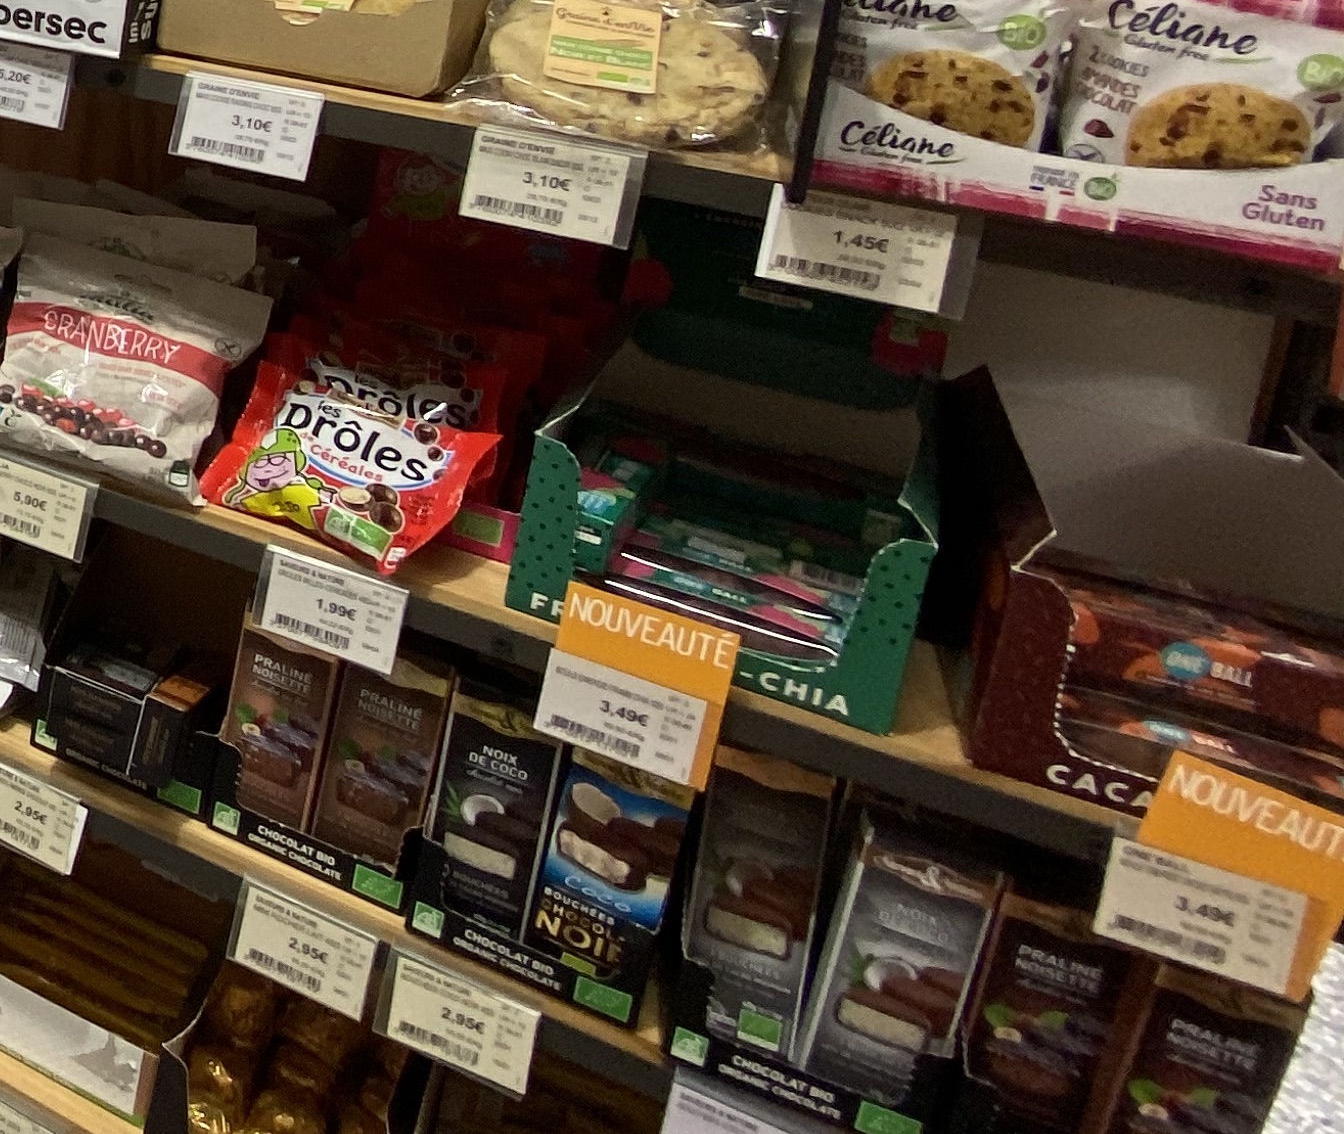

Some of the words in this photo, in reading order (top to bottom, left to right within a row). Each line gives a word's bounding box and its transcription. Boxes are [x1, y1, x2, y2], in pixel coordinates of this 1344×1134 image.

[231, 115, 272, 133] 3,10€
[841, 120, 955, 159] Céliane
[522, 171, 571, 192] 3,10€
[1258, 185, 1318, 210] Sans
[1241, 202, 1325, 232] Gluten
[832, 229, 889, 254] 1,45€
[43, 309, 182, 363] CRANBERRY
[283, 399, 430, 483] Drôles
[13, 491, 48, 512] 5,90€
[315, 597, 358, 622] 1,99€
[568, 592, 738, 670] NOUVEAUTÉ
[598, 698, 650, 728] 3,49€
[468, 751, 487, 767] DE
[489, 759, 529, 781] COCO
[482, 745, 519, 765] NOIX
[247, 832, 287, 858] ORGANIC
[288, 850, 343, 882] CHOCOLATE
[257, 823, 315, 859] CHOCOLAT
[316, 849, 336, 867] BIO
[543, 886, 616, 926] BOUCHÉES
[288, 935, 329, 965] 2,95€
[453, 936, 500, 966] ORGANIC
[500, 957, 562, 992] CHOCOLATE
[464, 929, 534, 966] CHOCOLAT
[534, 958, 555, 976] BIO
[440, 1006, 485, 1035] 2,95€
[731, 1054, 806, 1093] CHOCOLAT
